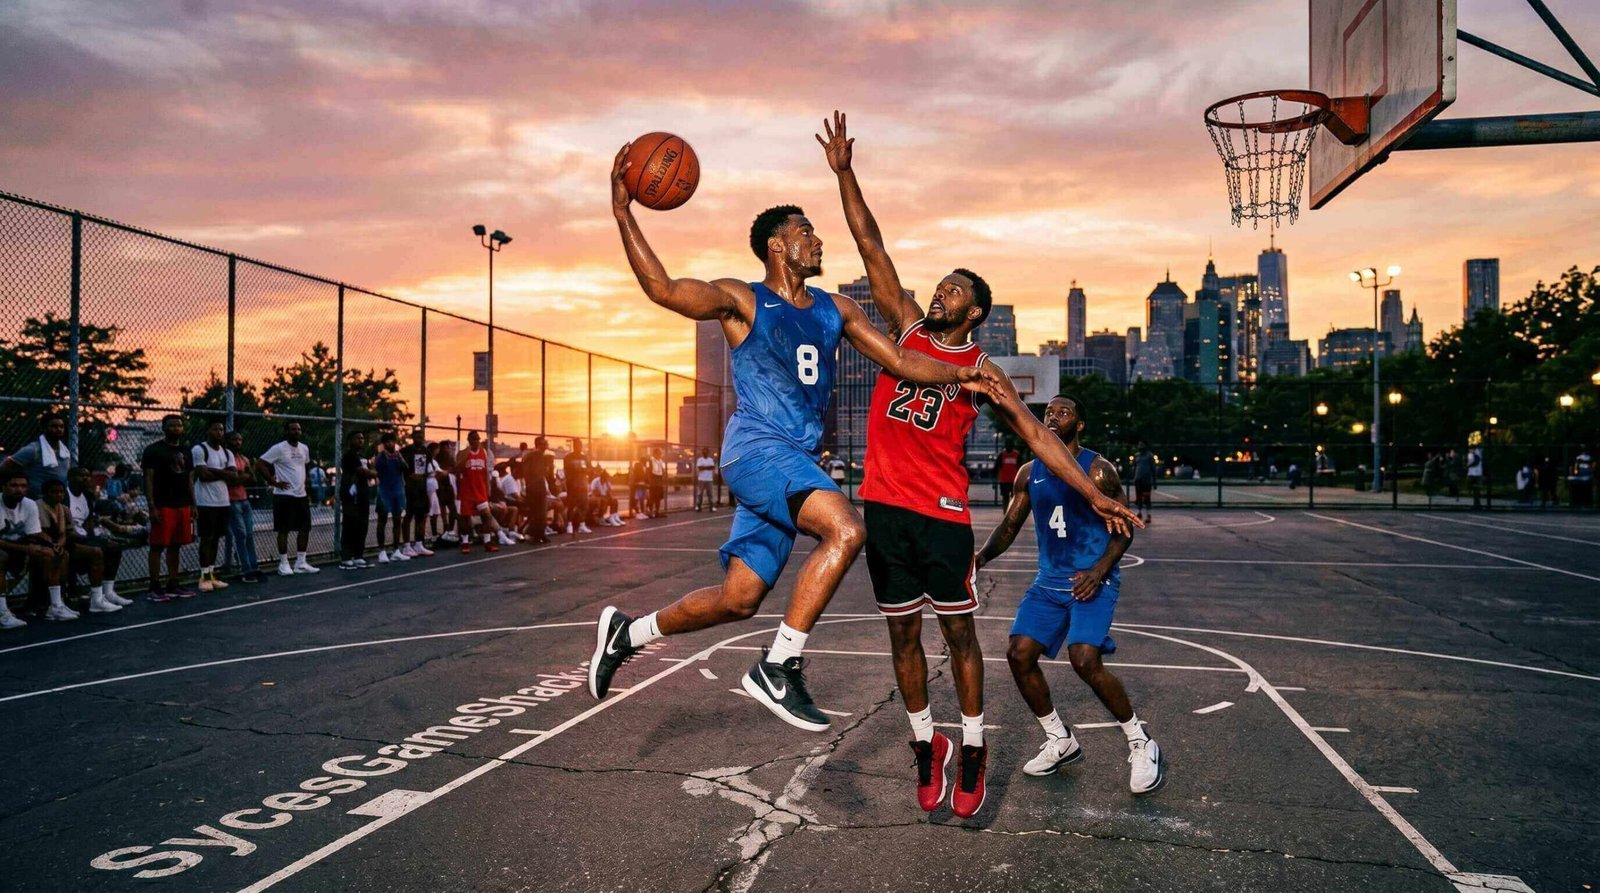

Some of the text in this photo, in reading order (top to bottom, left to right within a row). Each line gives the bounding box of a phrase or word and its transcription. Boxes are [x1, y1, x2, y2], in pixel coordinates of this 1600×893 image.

[644, 147, 680, 196] SPALDING
[796, 344, 819, 386] 8
[886, 379, 945, 432] 23
[1048, 505, 1067, 538] 4
